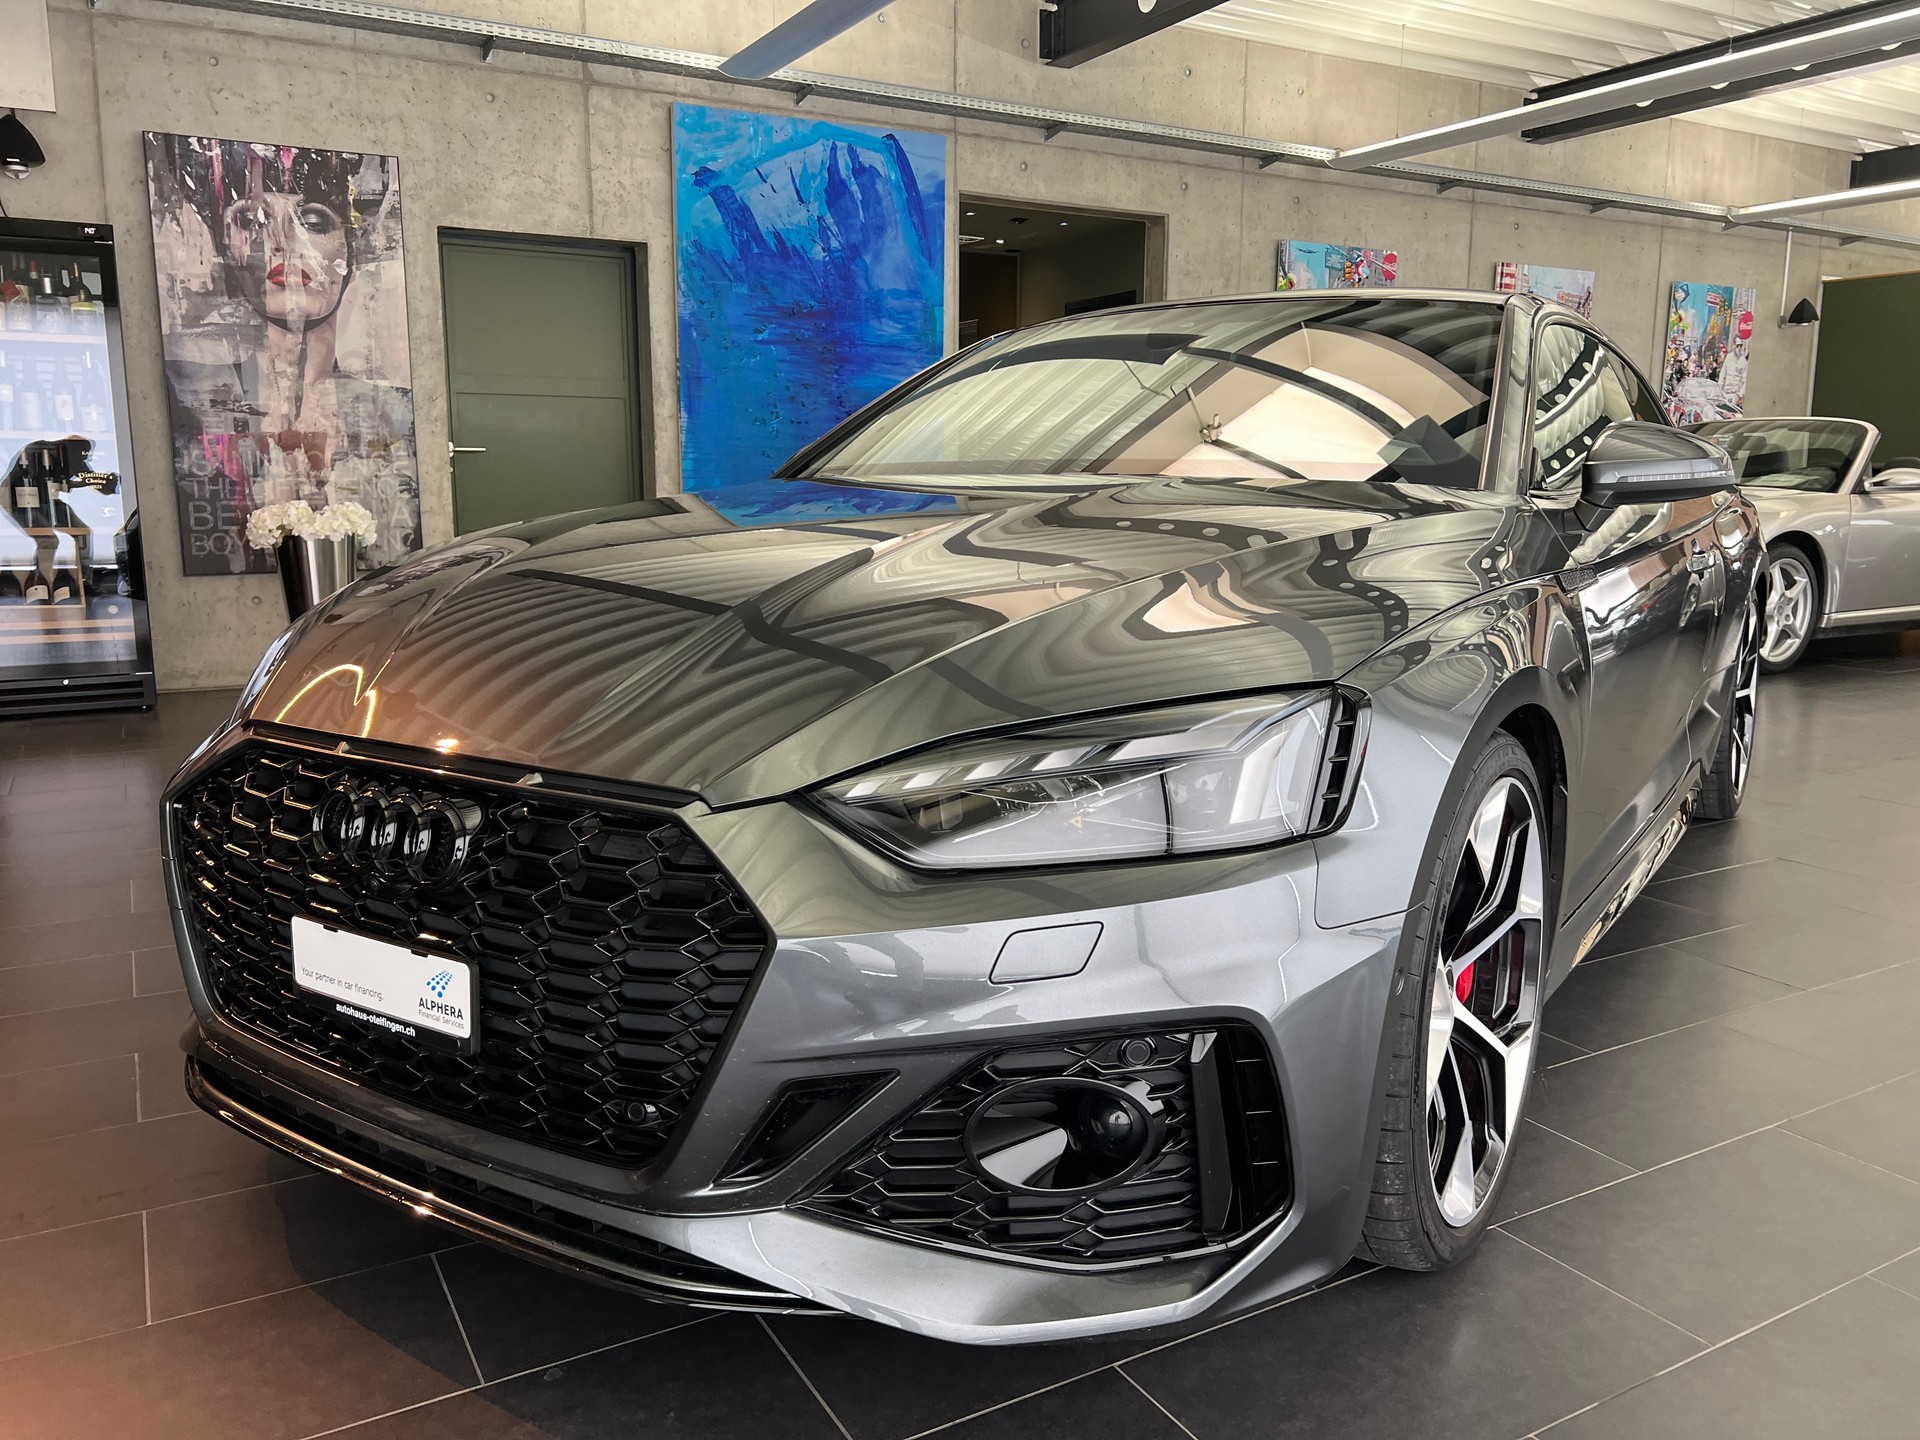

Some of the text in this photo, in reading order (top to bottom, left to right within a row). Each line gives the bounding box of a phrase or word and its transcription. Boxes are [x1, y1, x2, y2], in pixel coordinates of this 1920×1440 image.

[301, 966, 385, 1002] Your partner in car financing.
[335, 1003, 416, 1037] autohaus-otelfingen.ch
[418, 997, 464, 1021] ALPHERA
[418, 1009, 465, 1030] Financial Services
